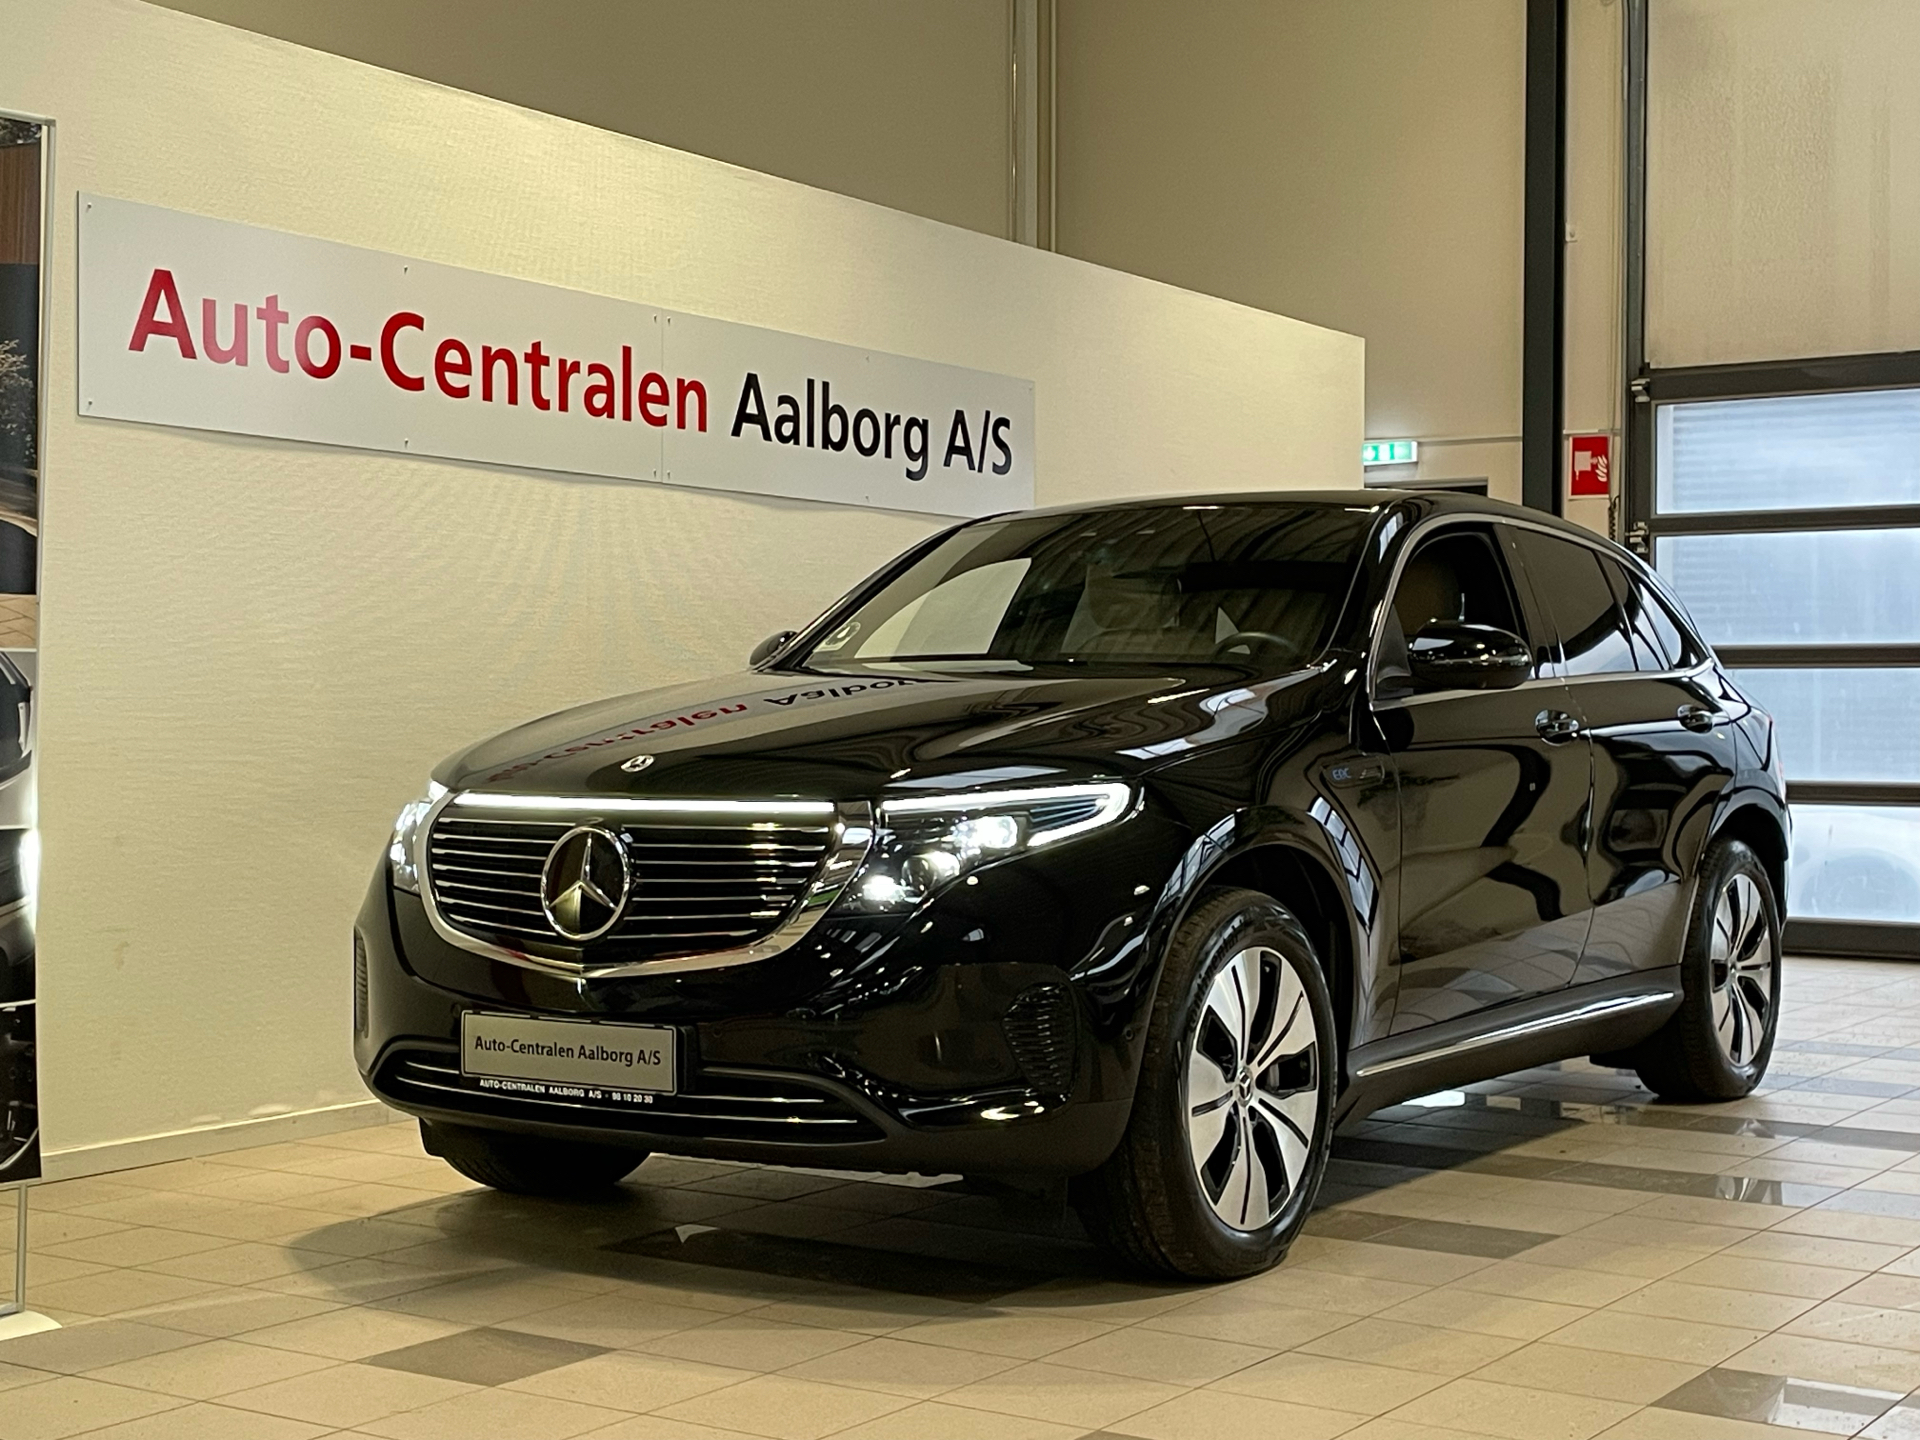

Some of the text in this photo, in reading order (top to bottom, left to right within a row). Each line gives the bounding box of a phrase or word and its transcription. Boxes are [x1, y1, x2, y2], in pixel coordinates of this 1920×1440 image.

[128, 268, 1012, 481] Auto-Centralen Aalborg A/S
[474, 1035, 661, 1067] Auto-Centralen Aalborg A/S
[480, 1079, 545, 1093] AUTO-CENTRALEN
[549, 1086, 585, 1097] AALBORG
[588, 1090, 602, 1099] A/S
